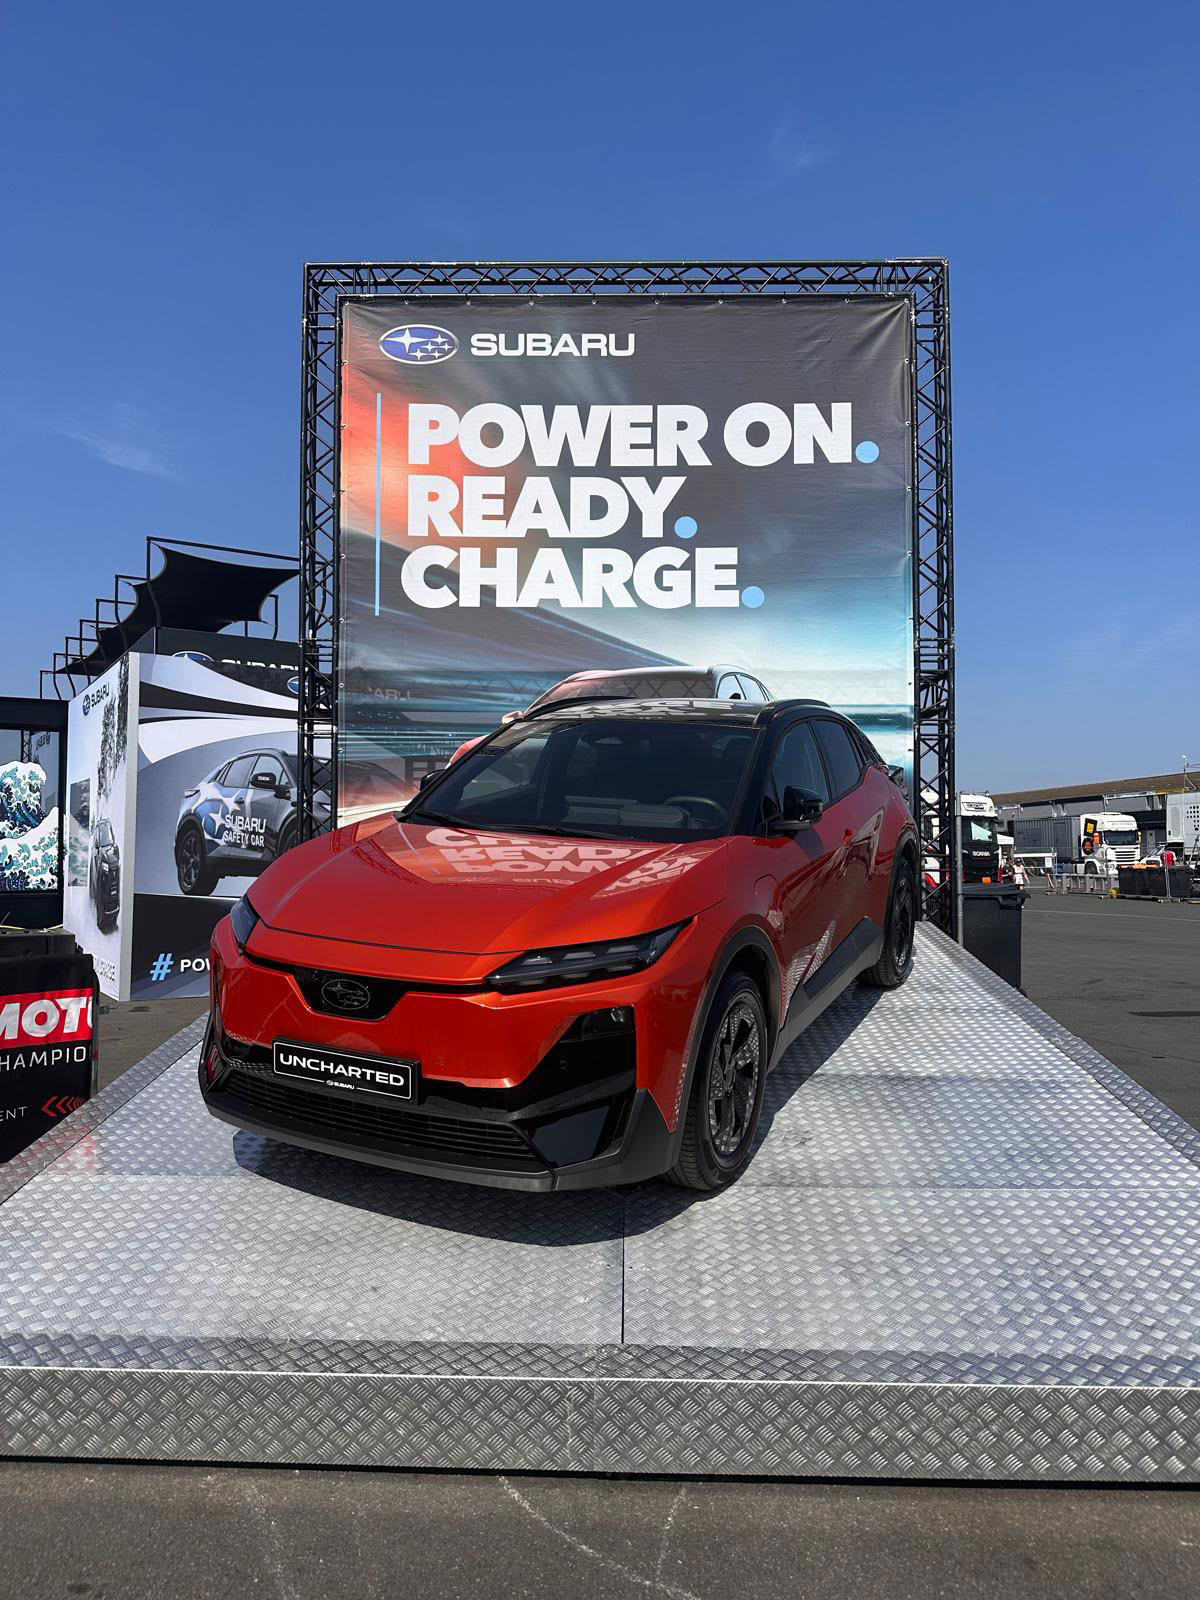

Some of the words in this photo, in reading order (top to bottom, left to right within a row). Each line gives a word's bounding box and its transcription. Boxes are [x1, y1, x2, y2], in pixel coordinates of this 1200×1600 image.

[470, 333, 635, 357] SUBARU
[408, 402, 712, 468] POWER
[723, 402, 880, 465] ON.
[407, 475, 698, 539] READY.
[401, 546, 765, 609] CHARGE.
[225, 814, 267, 834] SUBARU
[223, 830, 250, 845] SAFETY
[250, 834, 265, 847] CAR
[0, 1046, 88, 1072] HAMPIO
[279, 1053, 405, 1087] UNCHARTED
[333, 1081, 355, 1090] SUBARU
